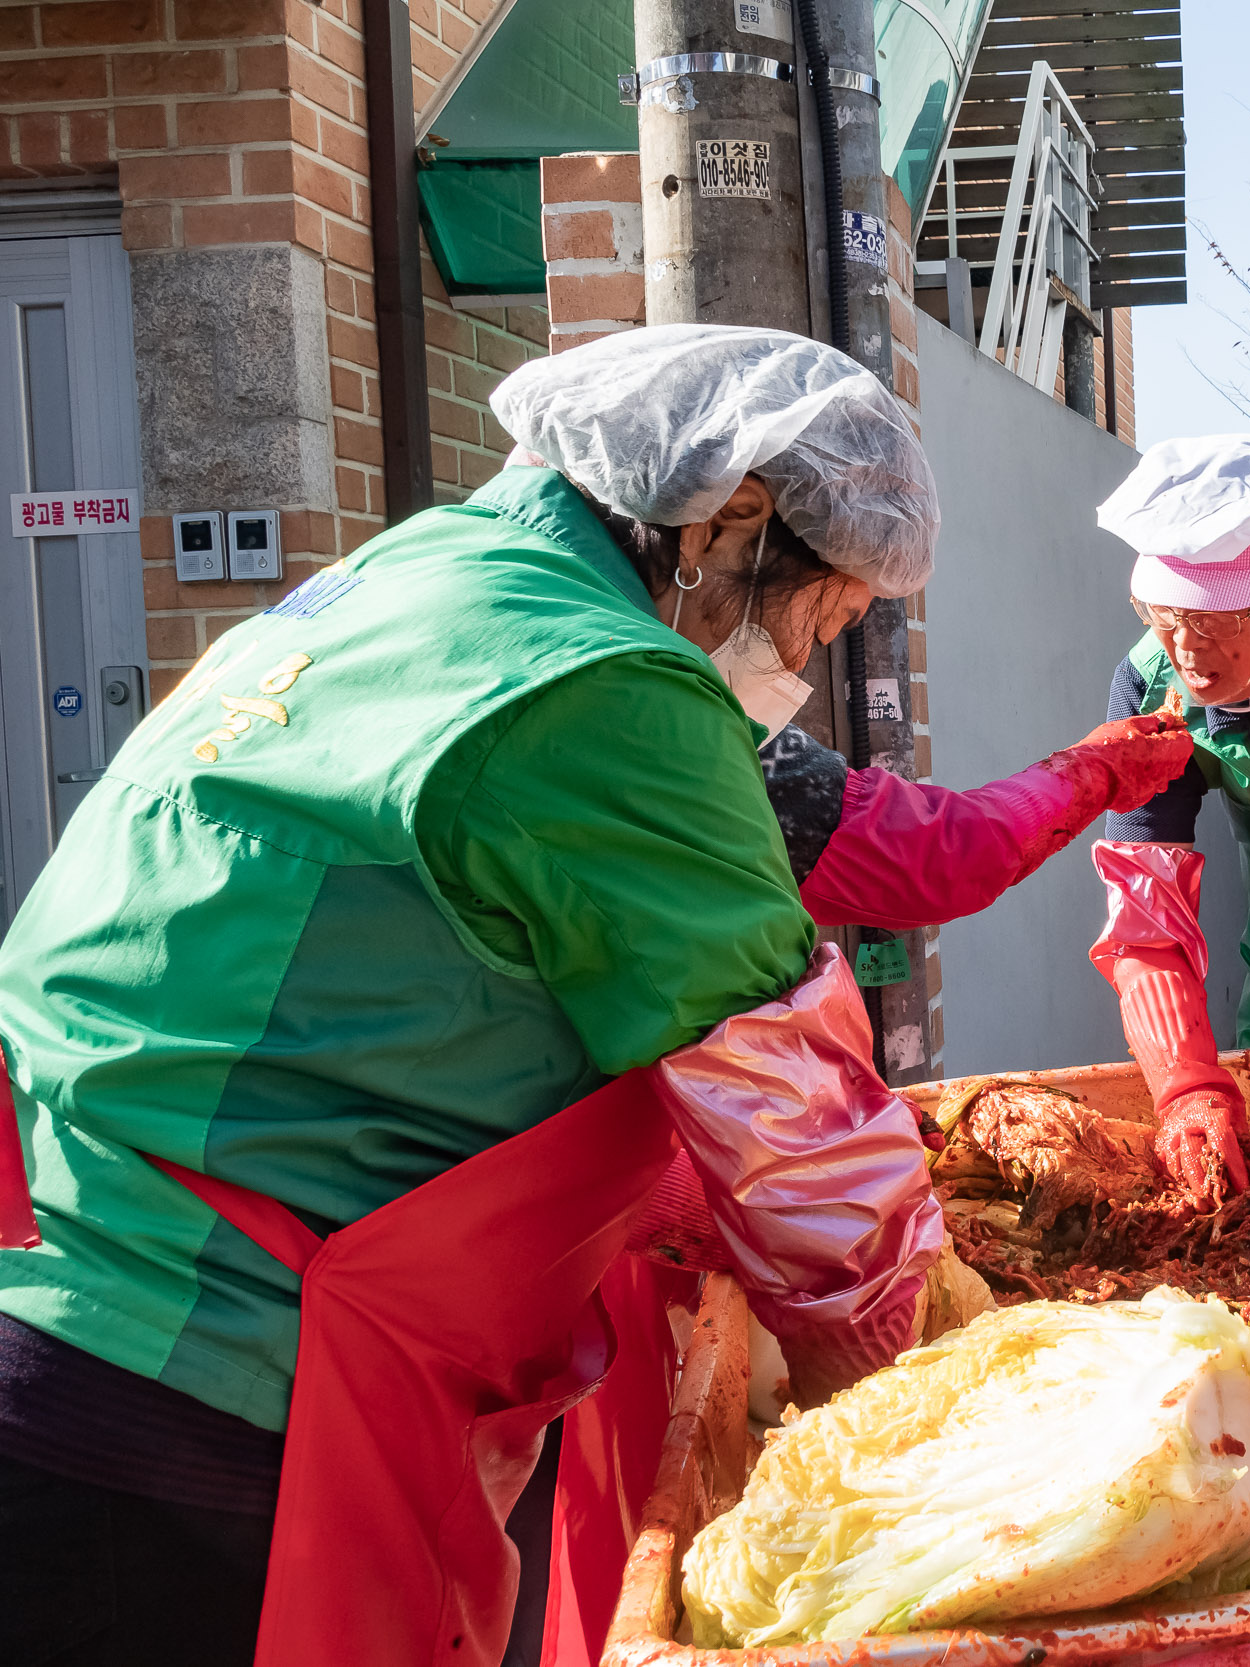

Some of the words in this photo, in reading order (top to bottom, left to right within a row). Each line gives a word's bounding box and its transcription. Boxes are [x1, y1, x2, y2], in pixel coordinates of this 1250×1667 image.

[710, 142, 767, 159] 이삿짐
[22, 501, 64, 528] 광고물
[73, 498, 130, 526] 부착금지
[58, 696, 78, 708] ADT
[861, 963, 874, 972] SK
